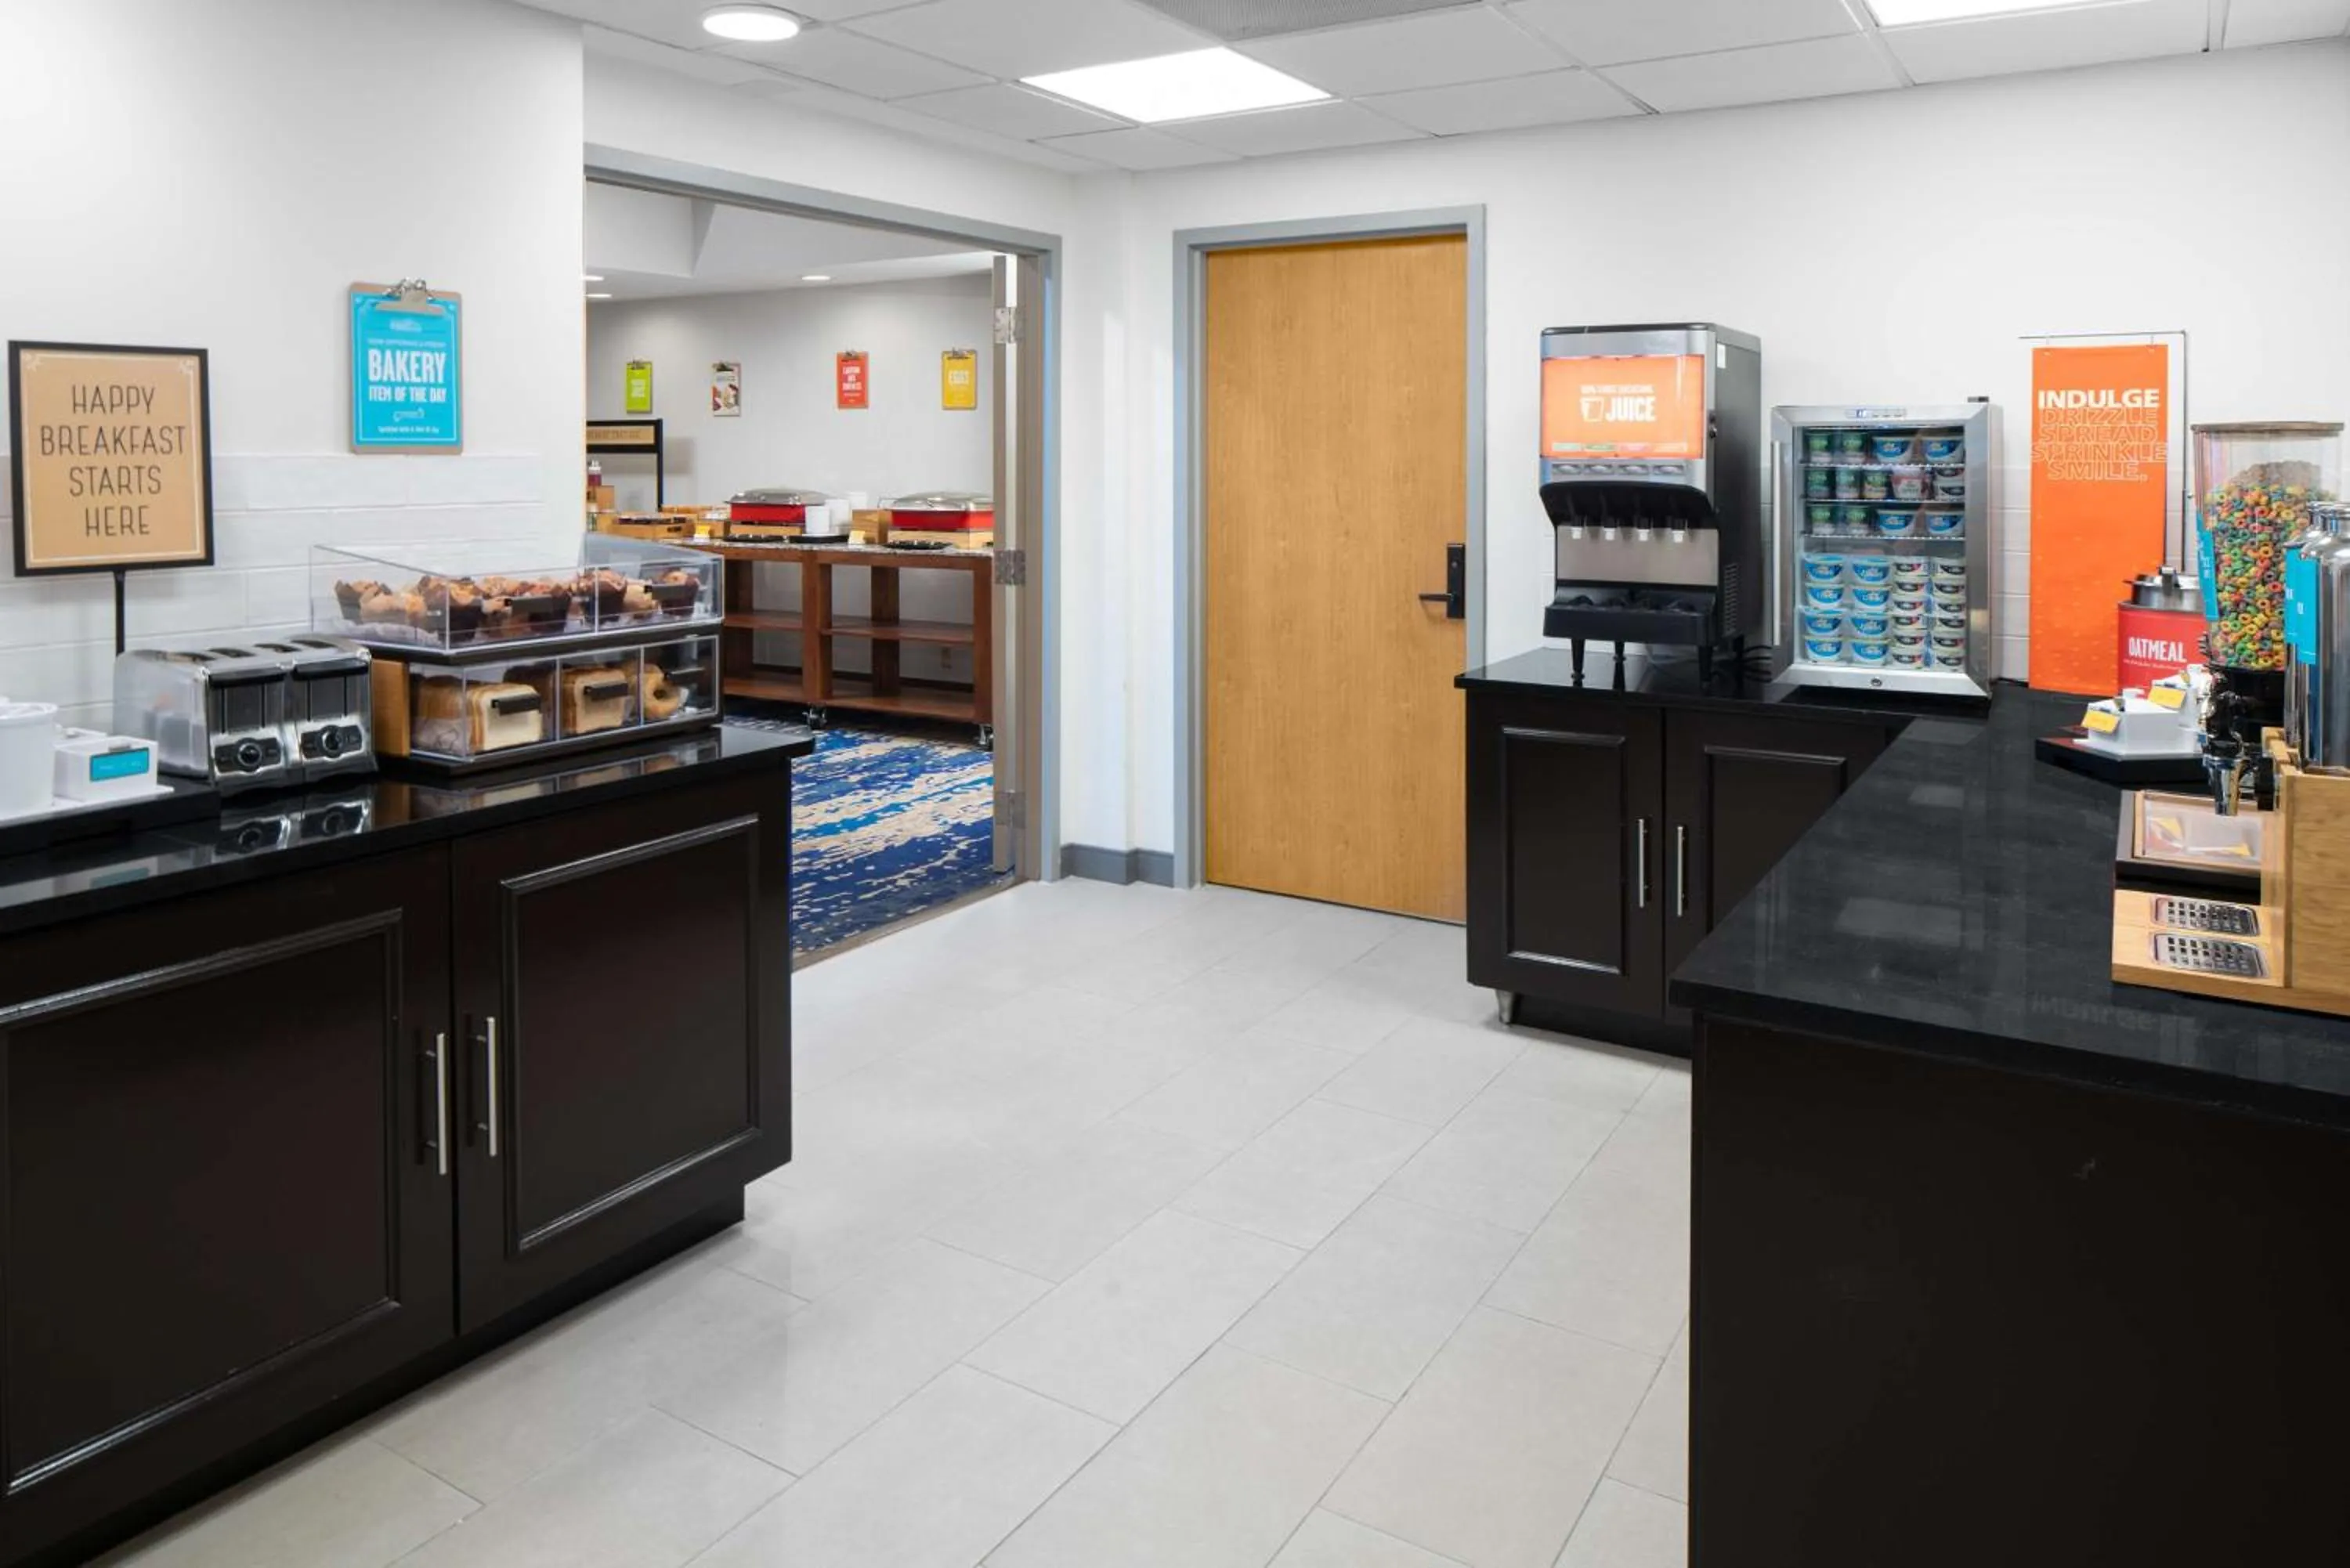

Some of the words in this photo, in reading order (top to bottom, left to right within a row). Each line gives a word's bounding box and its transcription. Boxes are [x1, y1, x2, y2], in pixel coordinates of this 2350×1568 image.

[368, 349, 446, 383] BAKERY
[72, 385, 154, 414] HAPPY
[369, 385, 391, 402] ITEM
[394, 386, 406, 402] OF
[410, 386, 427, 402] THE
[429, 387, 446, 403] DAY
[2038, 388, 2160, 409] INDULGE
[1606, 396, 1655, 422] JUICE
[2041, 407, 2159, 427] DRIZZLE
[40, 425, 186, 456] BREAKFAST
[2040, 425, 2159, 443] SPREAD
[2030, 443, 2167, 462] SPRINKLE
[69, 465, 161, 497] STARTS
[2047, 461, 2148, 482] SMILE.
[85, 505, 150, 537] HERE
[2128, 636, 2187, 663] OATMEAL
